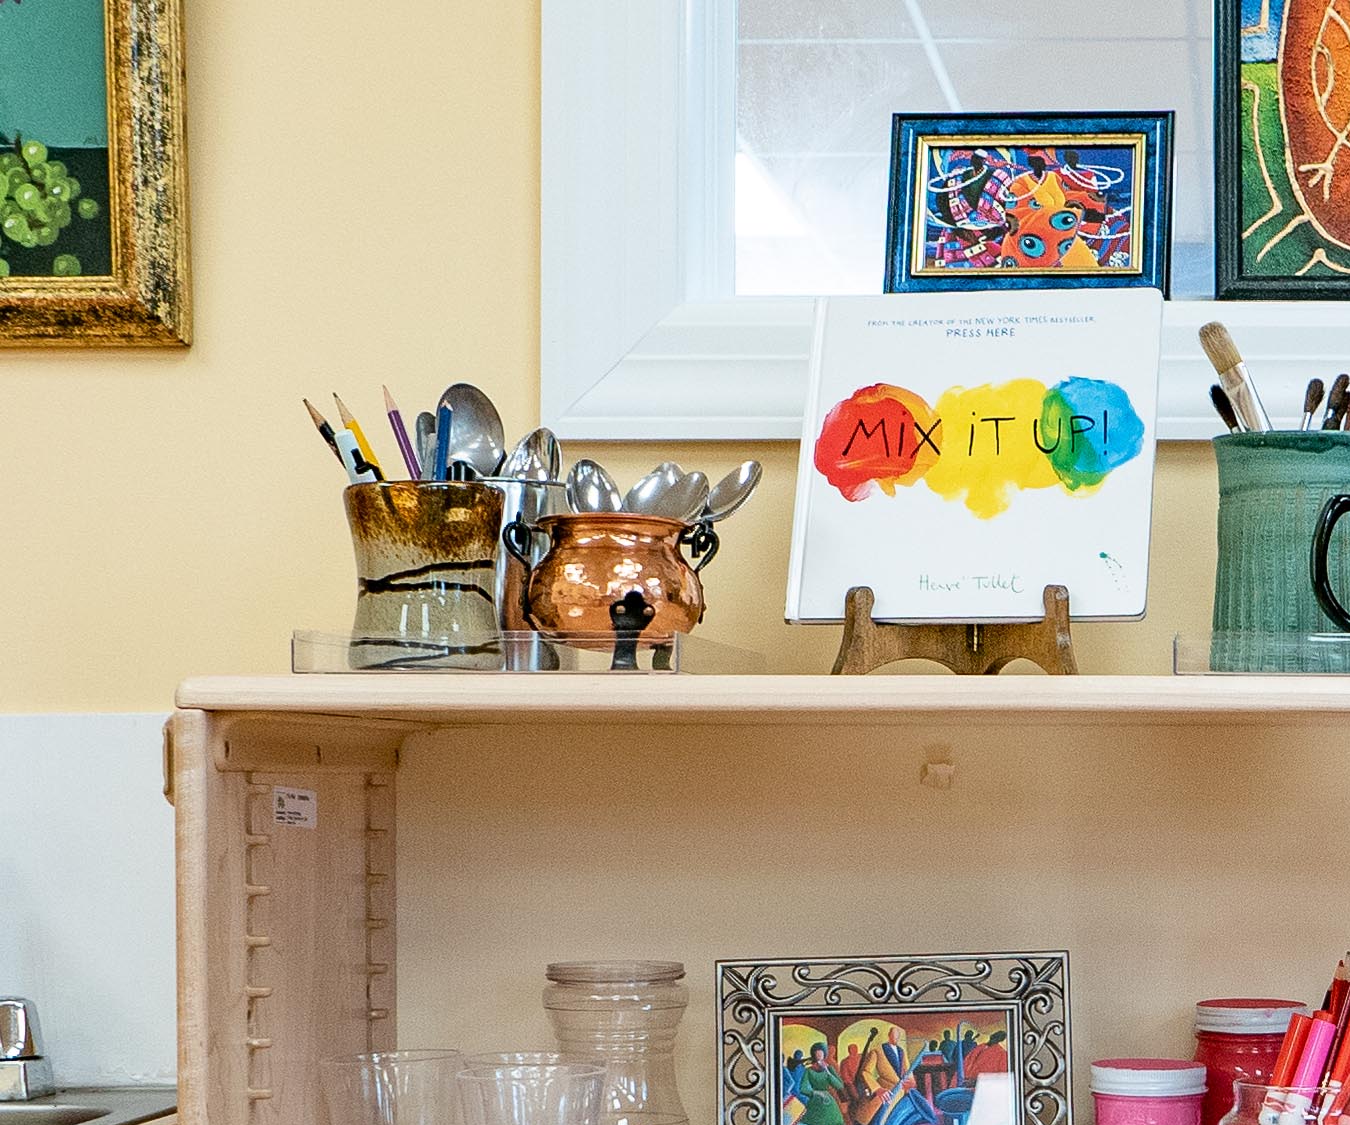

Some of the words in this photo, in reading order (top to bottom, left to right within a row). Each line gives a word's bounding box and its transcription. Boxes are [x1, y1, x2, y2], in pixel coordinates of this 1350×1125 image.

[867, 319, 889, 327] FROM
[892, 319, 905, 327] THE
[975, 317, 995, 325] NEW
[998, 316, 1021, 325] YORK
[1023, 316, 1048, 324] TIMES
[945, 327, 982, 338] PRESS
[985, 327, 1016, 338] HERE
[1033, 409, 1108, 456] UP!
[972, 573, 1025, 593] Tullet
